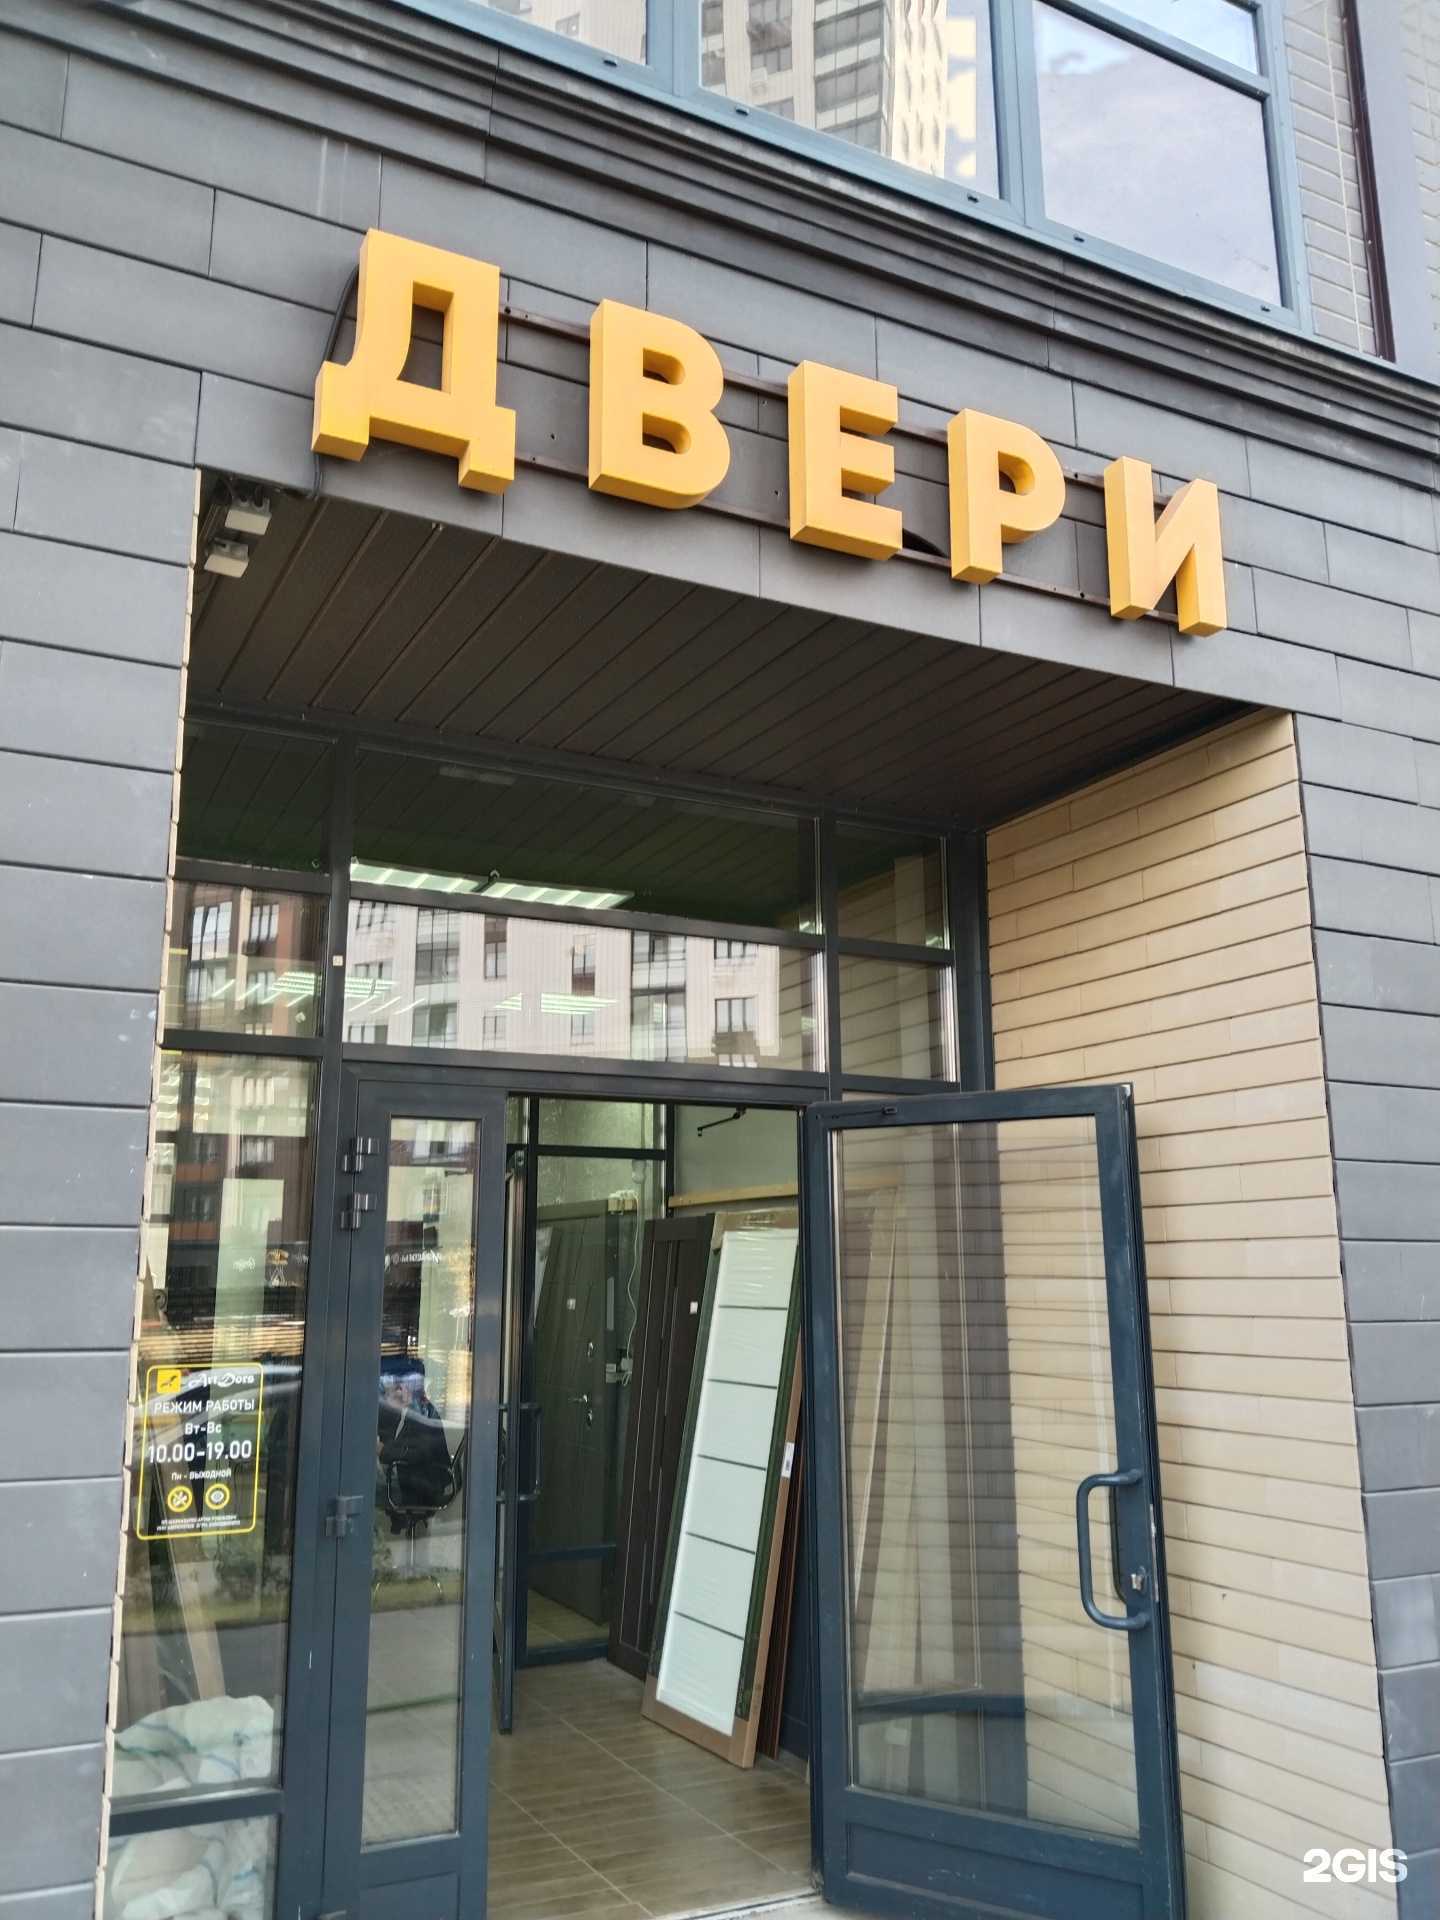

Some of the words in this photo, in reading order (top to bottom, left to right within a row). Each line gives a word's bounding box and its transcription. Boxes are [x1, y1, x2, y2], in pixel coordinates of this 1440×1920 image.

[311, 228, 1227, 637] ДВЕРИ
[154, 1401, 202, 1414] РЕЖИМ
[205, 1399, 255, 1412] РАБОТЫ
[184, 1422, 222, 1435] Вт-Вс
[148, 1440, 252, 1463] 10.00-19.00
